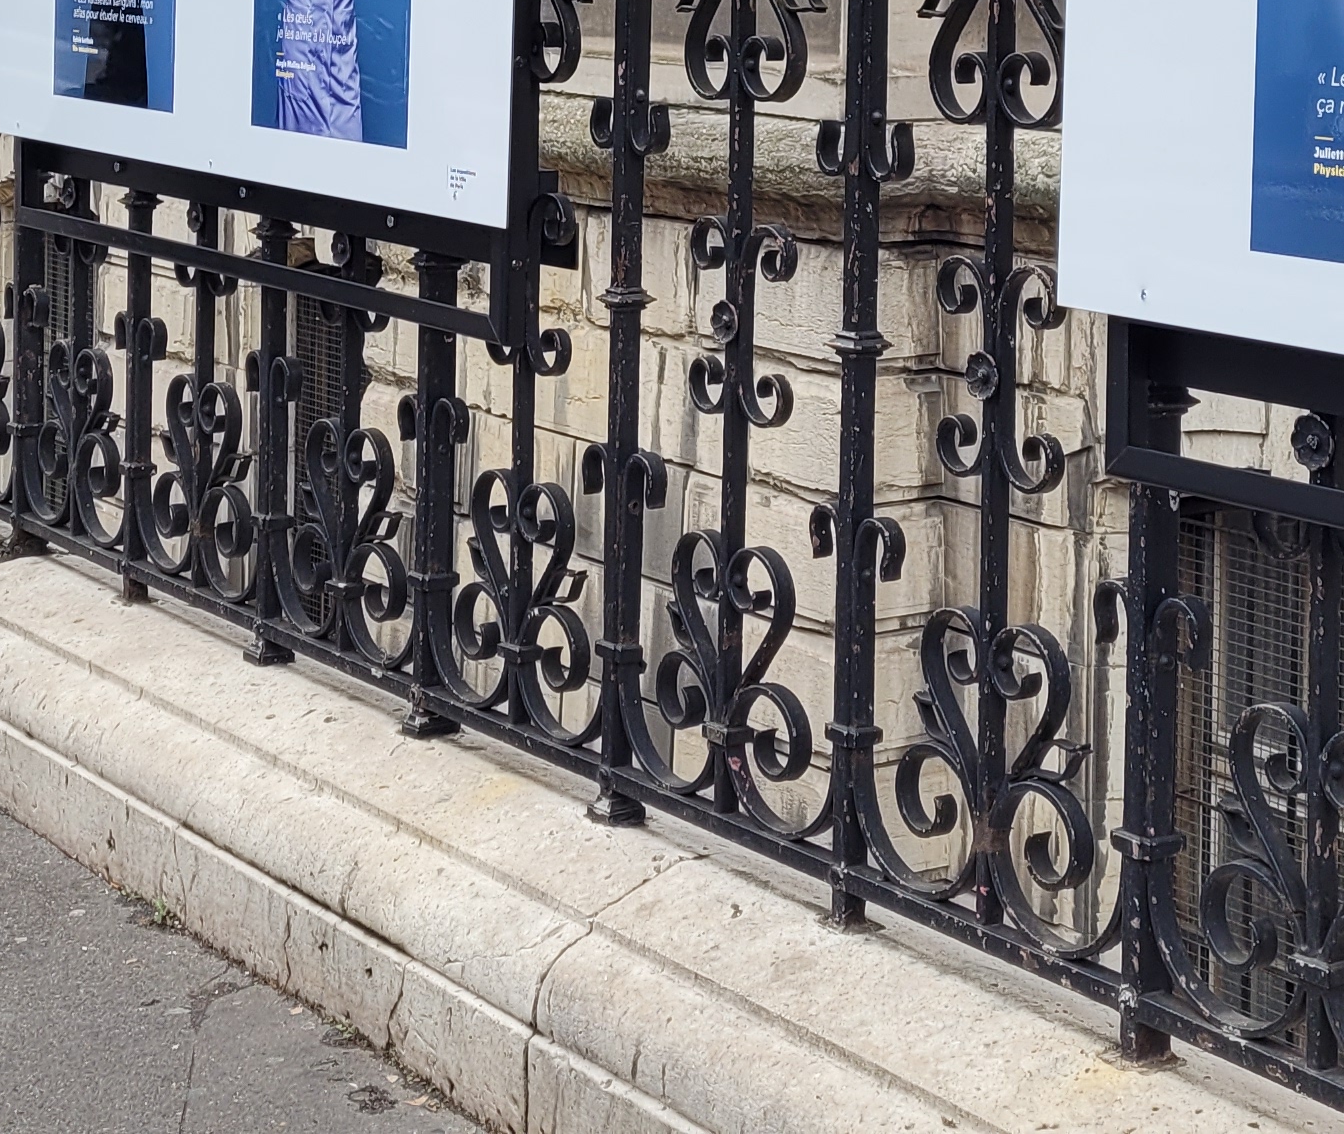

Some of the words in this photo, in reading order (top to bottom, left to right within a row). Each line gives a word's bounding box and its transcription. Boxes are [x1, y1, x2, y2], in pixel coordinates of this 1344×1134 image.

[283, 8, 294, 23] Les
[294, 29, 312, 42] aime
[318, 28, 325, 43] la
[326, 30, 347, 48] loupe
[1316, 98, 1334, 118] ça
